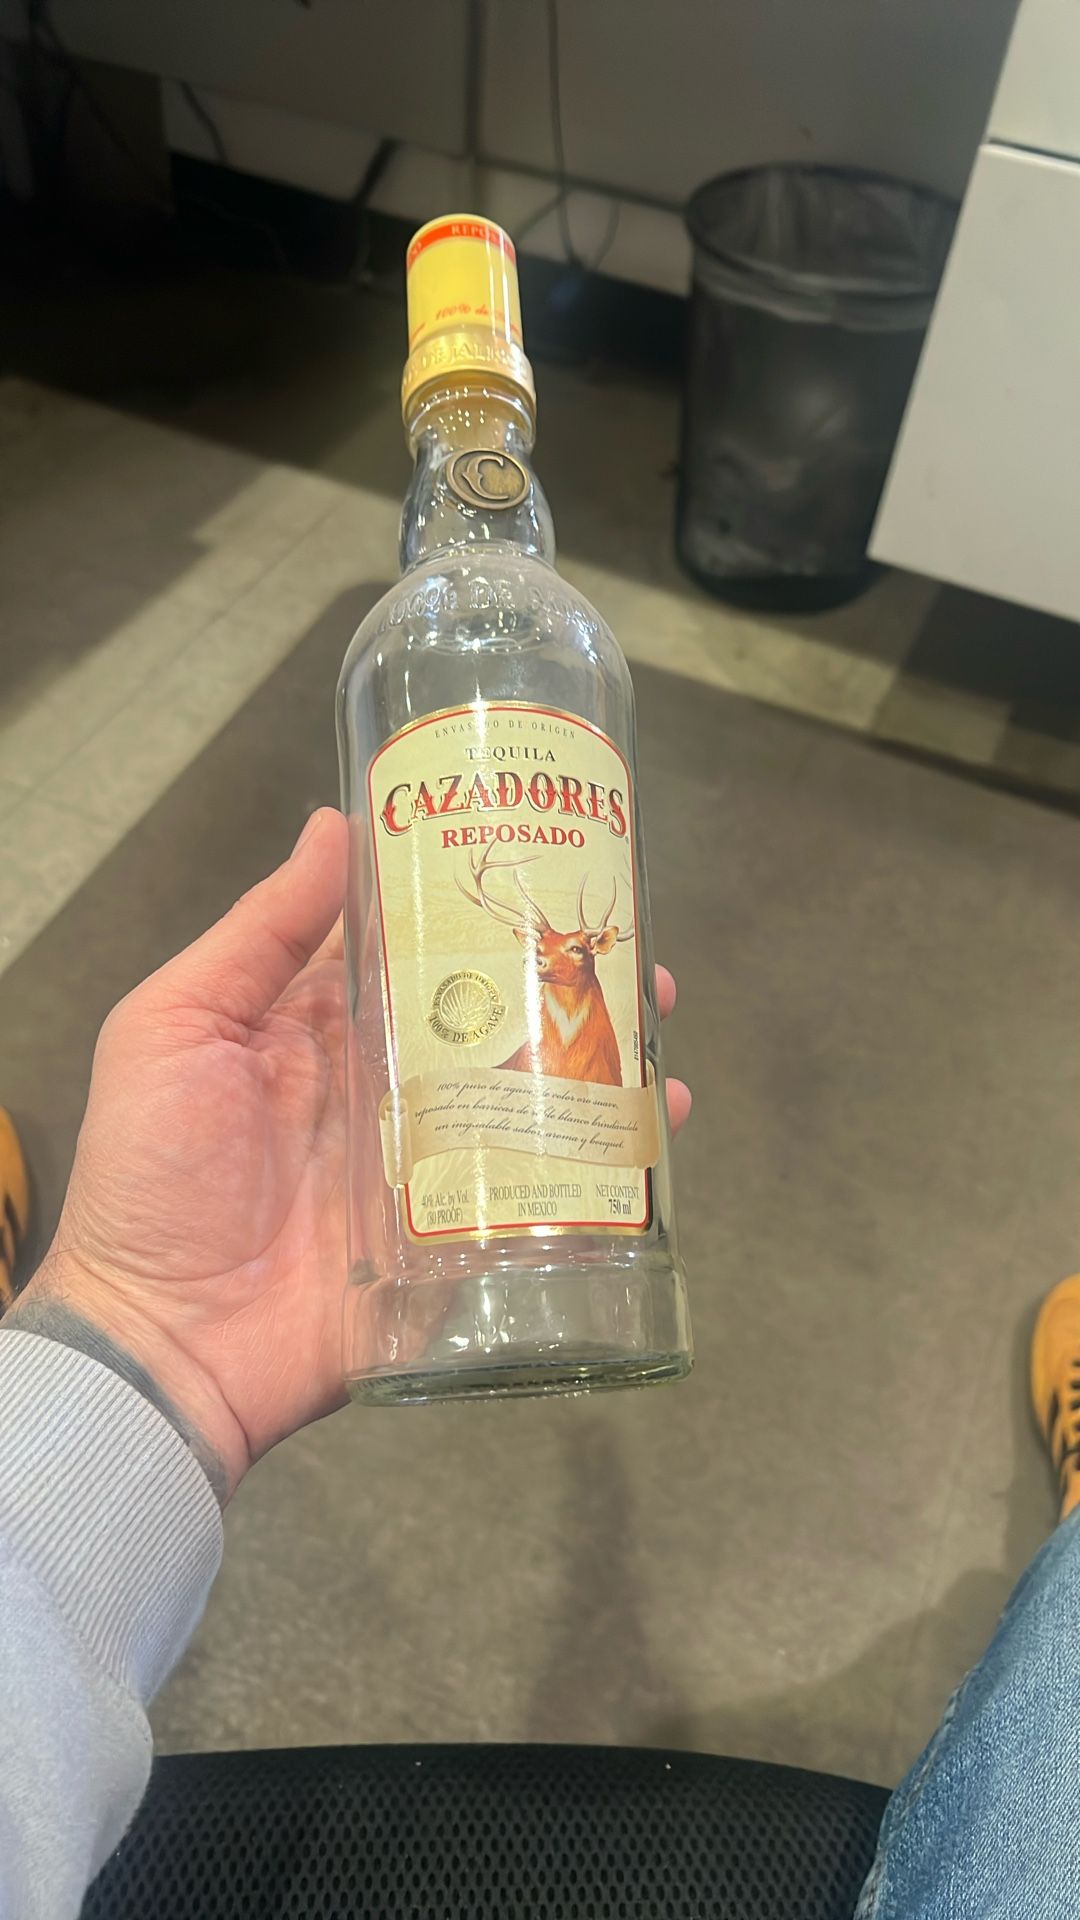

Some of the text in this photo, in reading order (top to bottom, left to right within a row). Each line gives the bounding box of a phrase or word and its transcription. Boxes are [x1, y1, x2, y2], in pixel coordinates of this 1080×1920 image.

[462, 455, 509, 500] C
[434, 719, 576, 739] ENVASDO DE ORIGEN
[465, 746, 556, 762] TEQUILA
[380, 771, 627, 838] CAZADORES
[441, 824, 586, 849] REPOSADO
[452, 1031, 469, 1043] DE
[472, 1007, 504, 1040] AGAVE
[437, 1082, 460, 1092] 100%
[456, 1081, 487, 1097] puro
[489, 1080, 502, 1092] de
[552, 1090, 575, 1101] color
[576, 1097, 591, 1105] oro
[415, 1098, 456, 1124] reposado
[472, 1096, 514, 1113] barricas
[516, 1104, 529, 1114] de
[531, 1105, 555, 1119] rble
[557, 1108, 590, 1125] blanco
[434, 1123, 449, 1132] un
[545, 1131, 579, 1142] aroma
[578, 1138, 587, 1151] y
[448, 1190, 456, 1210] by
[489, 1183, 582, 1201] PRODUCED AND BOTTLED
[596, 1184, 640, 1199] NET CONTENT
[437, 1207, 464, 1225] PROOF)
[518, 1201, 557, 1217] IN MEXICO
[608, 1199, 632, 1215] 750 ml
